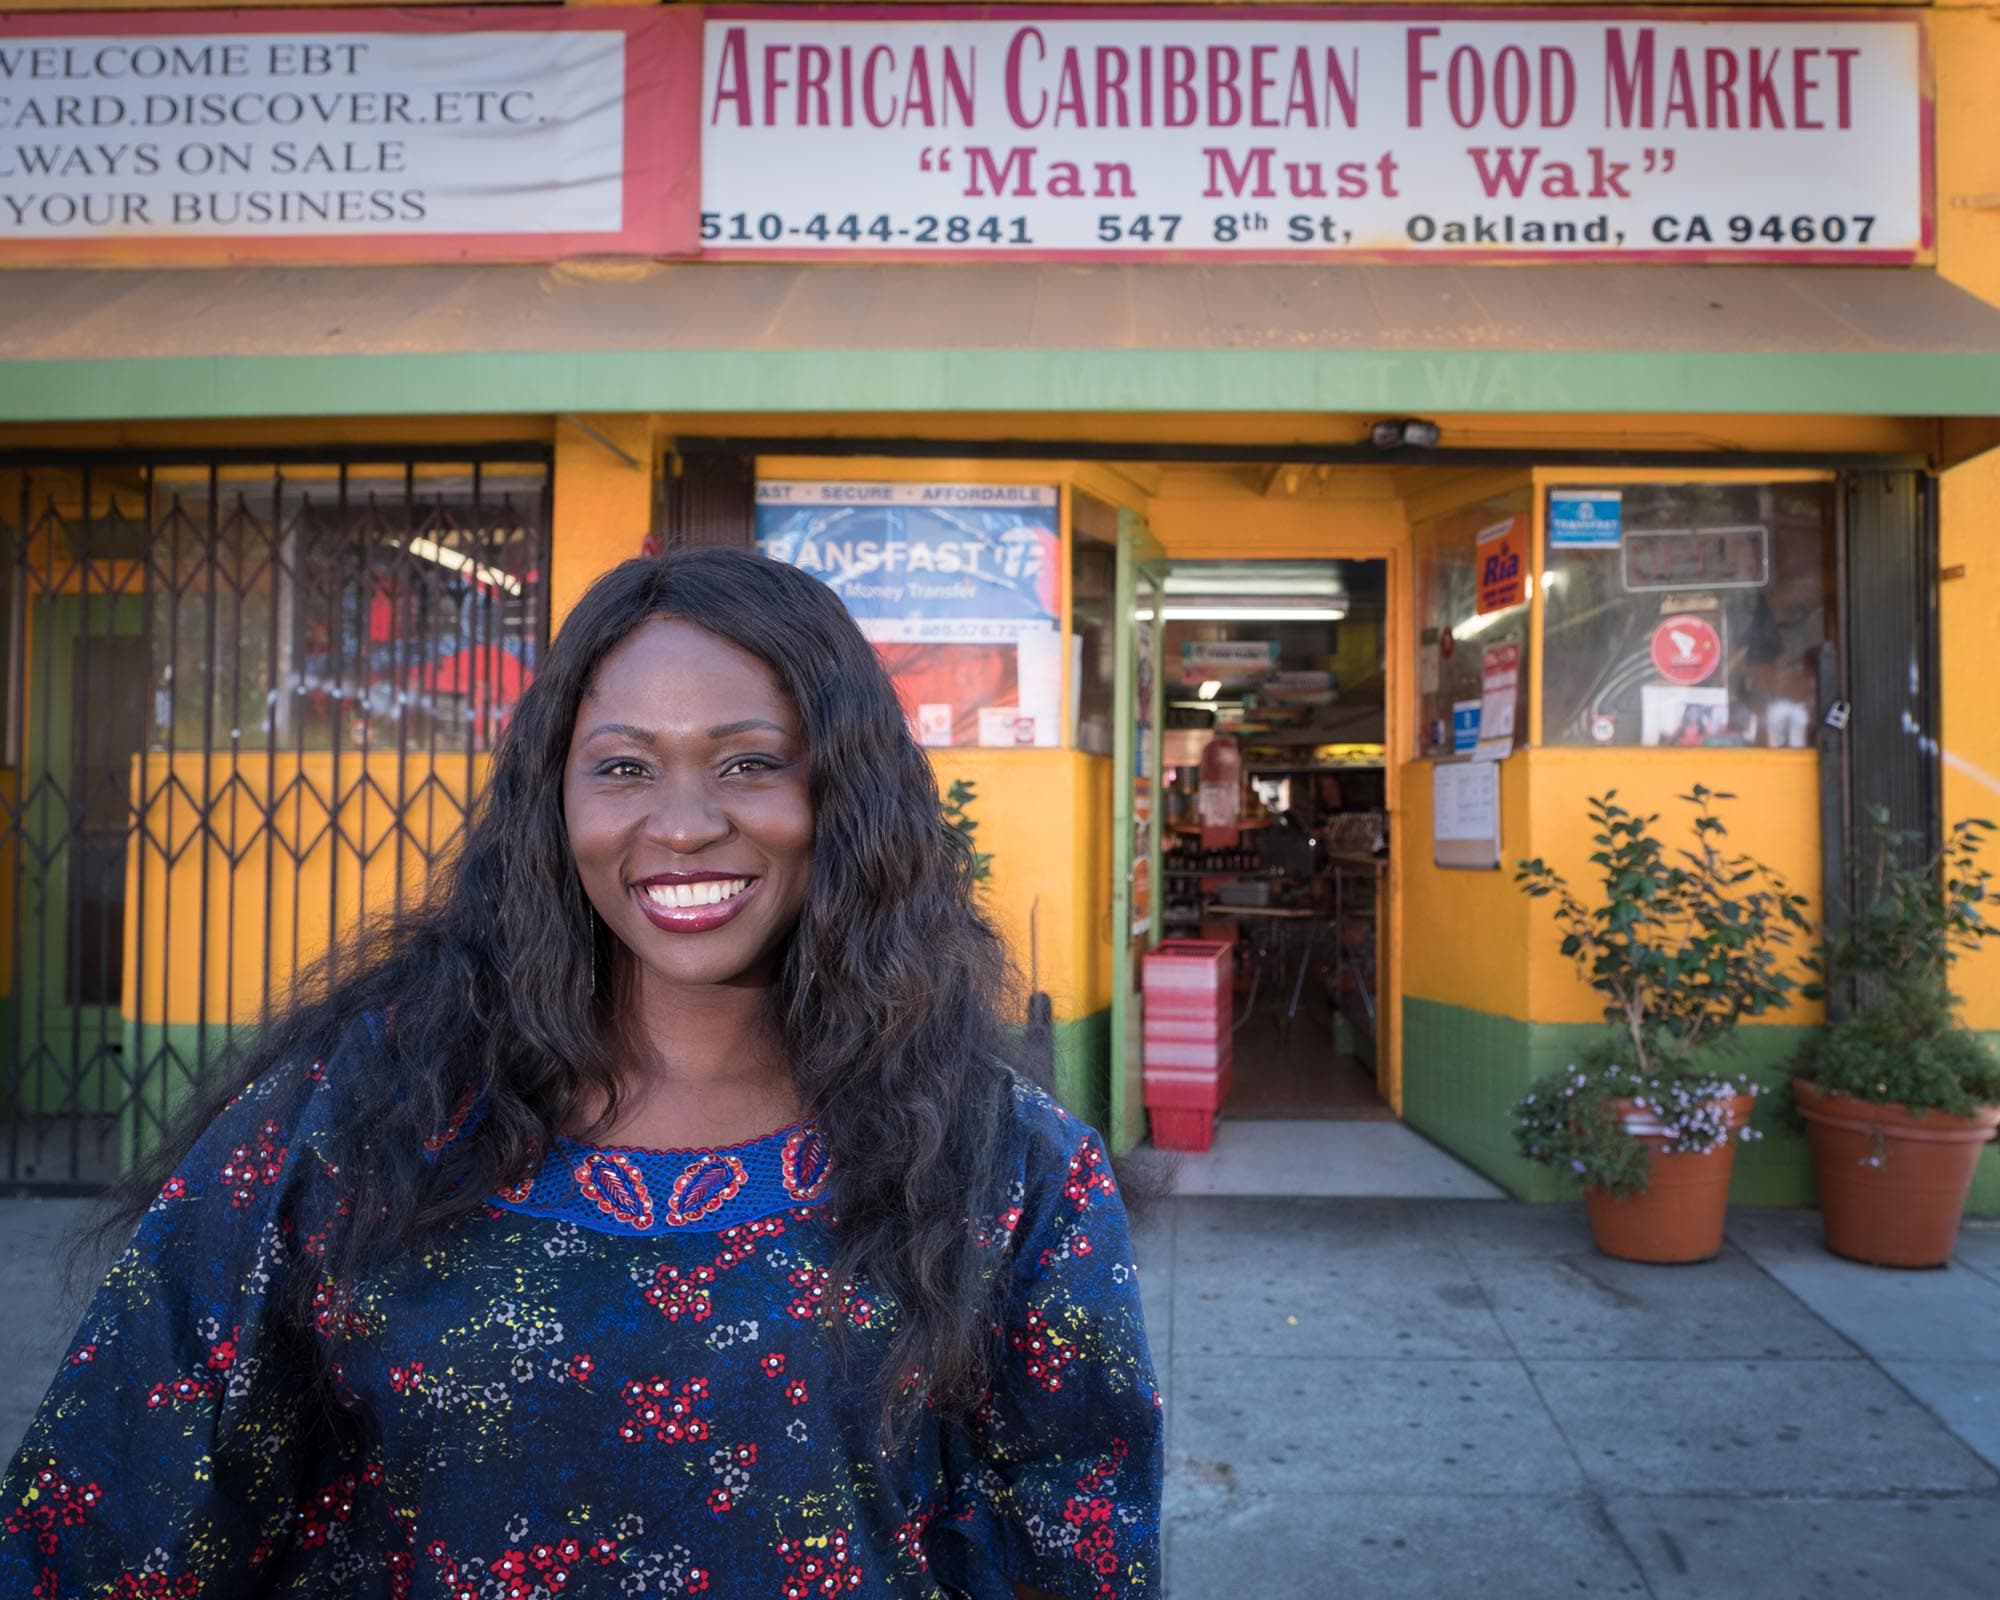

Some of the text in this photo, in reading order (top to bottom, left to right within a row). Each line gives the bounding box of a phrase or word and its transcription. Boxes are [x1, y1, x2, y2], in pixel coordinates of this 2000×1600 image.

[268, 44, 368, 76] EBT
[711, 27, 1860, 130] AFRICAN CARIBBEAN FOOD MARKET
[177, 143, 252, 174] ON
[272, 142, 404, 174] SALE
[1203, 148, 1399, 199] Must
[3, 190, 427, 226] YOUR BUSINESS
[700, 213, 1877, 246] 510-444-2841 547 8th St, Oakland, CA 94607
[822, 486, 894, 500] SECURE
[922, 486, 1041, 501] AFFORDABLE
[757, 541, 984, 573] RANSFAST
[1484, 541, 1519, 588] Ria
